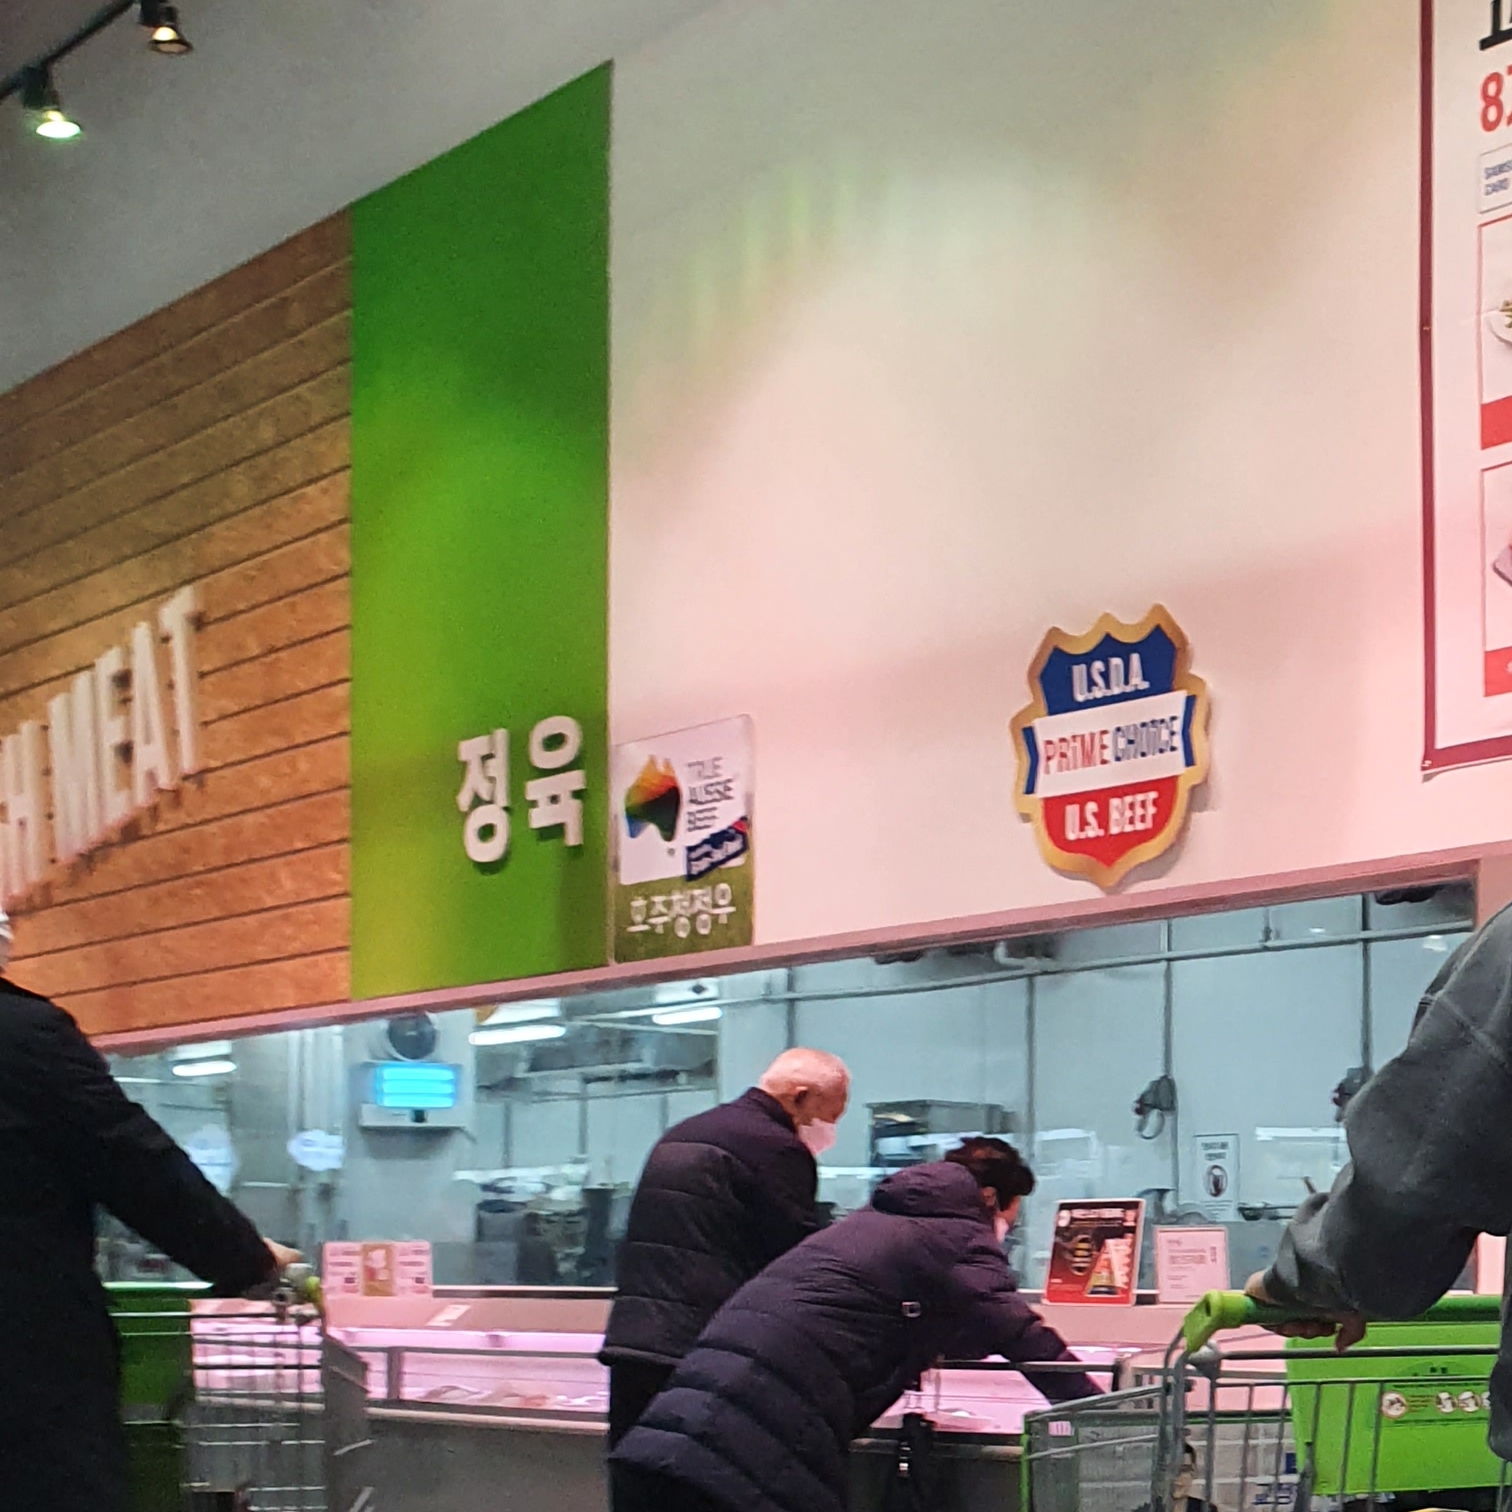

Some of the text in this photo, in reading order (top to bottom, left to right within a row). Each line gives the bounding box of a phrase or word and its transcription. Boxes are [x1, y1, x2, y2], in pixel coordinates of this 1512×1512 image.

[50, 584, 198, 865] MEAT
[1043, 715, 1179, 775] PRIME CHOICE
[457, 715, 587, 863] 정육
[1065, 790, 1159, 841] U.S. BEEF
